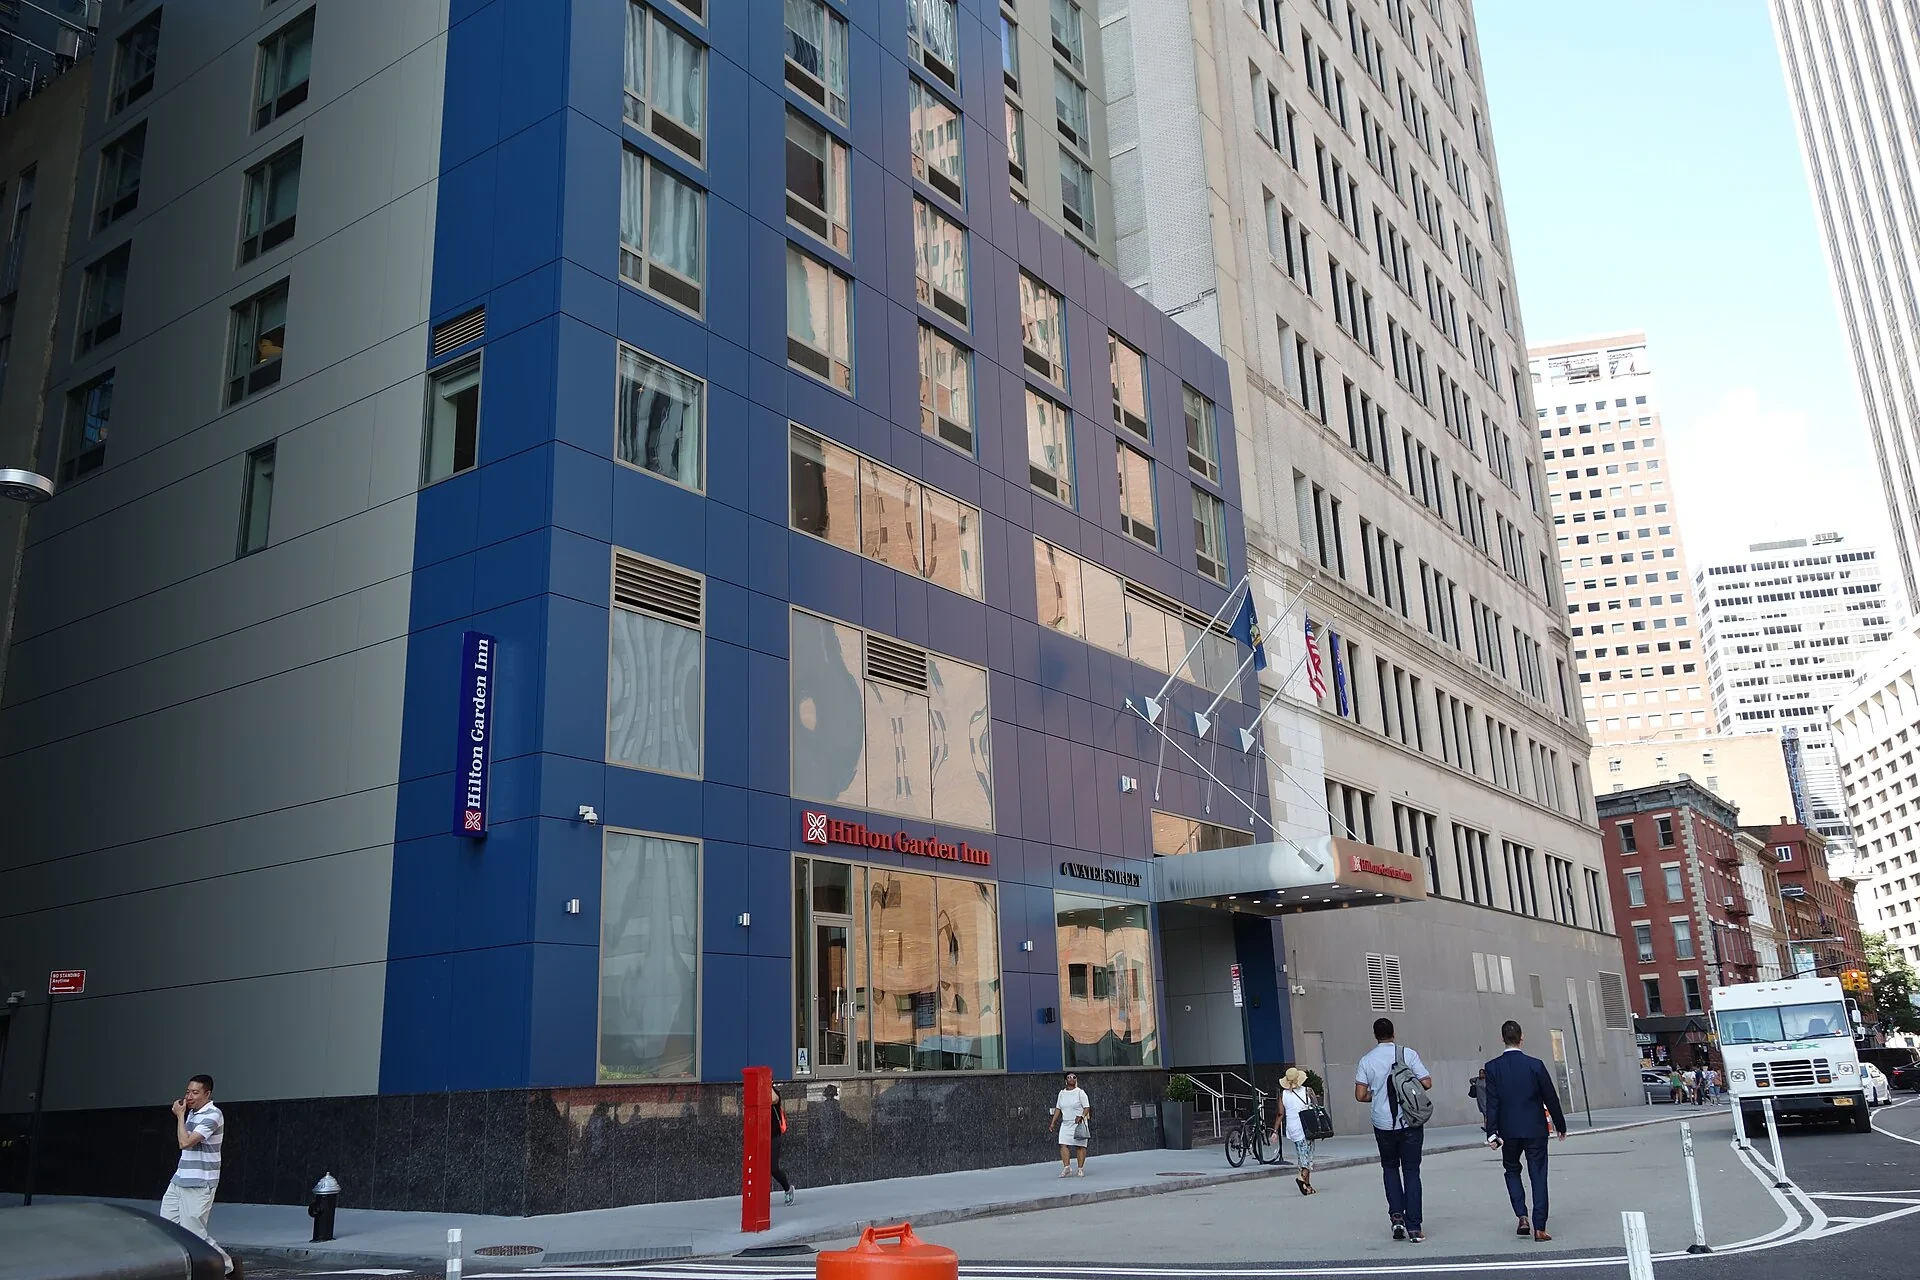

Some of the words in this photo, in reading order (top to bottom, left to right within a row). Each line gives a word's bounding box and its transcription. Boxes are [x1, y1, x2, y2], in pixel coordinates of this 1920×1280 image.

[474, 639, 489, 671] Inn
[471, 675, 487, 742] Garden
[467, 746, 483, 809] Hilton
[828, 819, 893, 851] Hilton
[895, 831, 958, 861] Garden
[959, 841, 991, 865] Inn
[1069, 863, 1107, 881] WATER
[1106, 869, 1142, 887] STREET
[800, 1050, 806, 1061] A
[1752, 1043, 1821, 1052] FedEx
